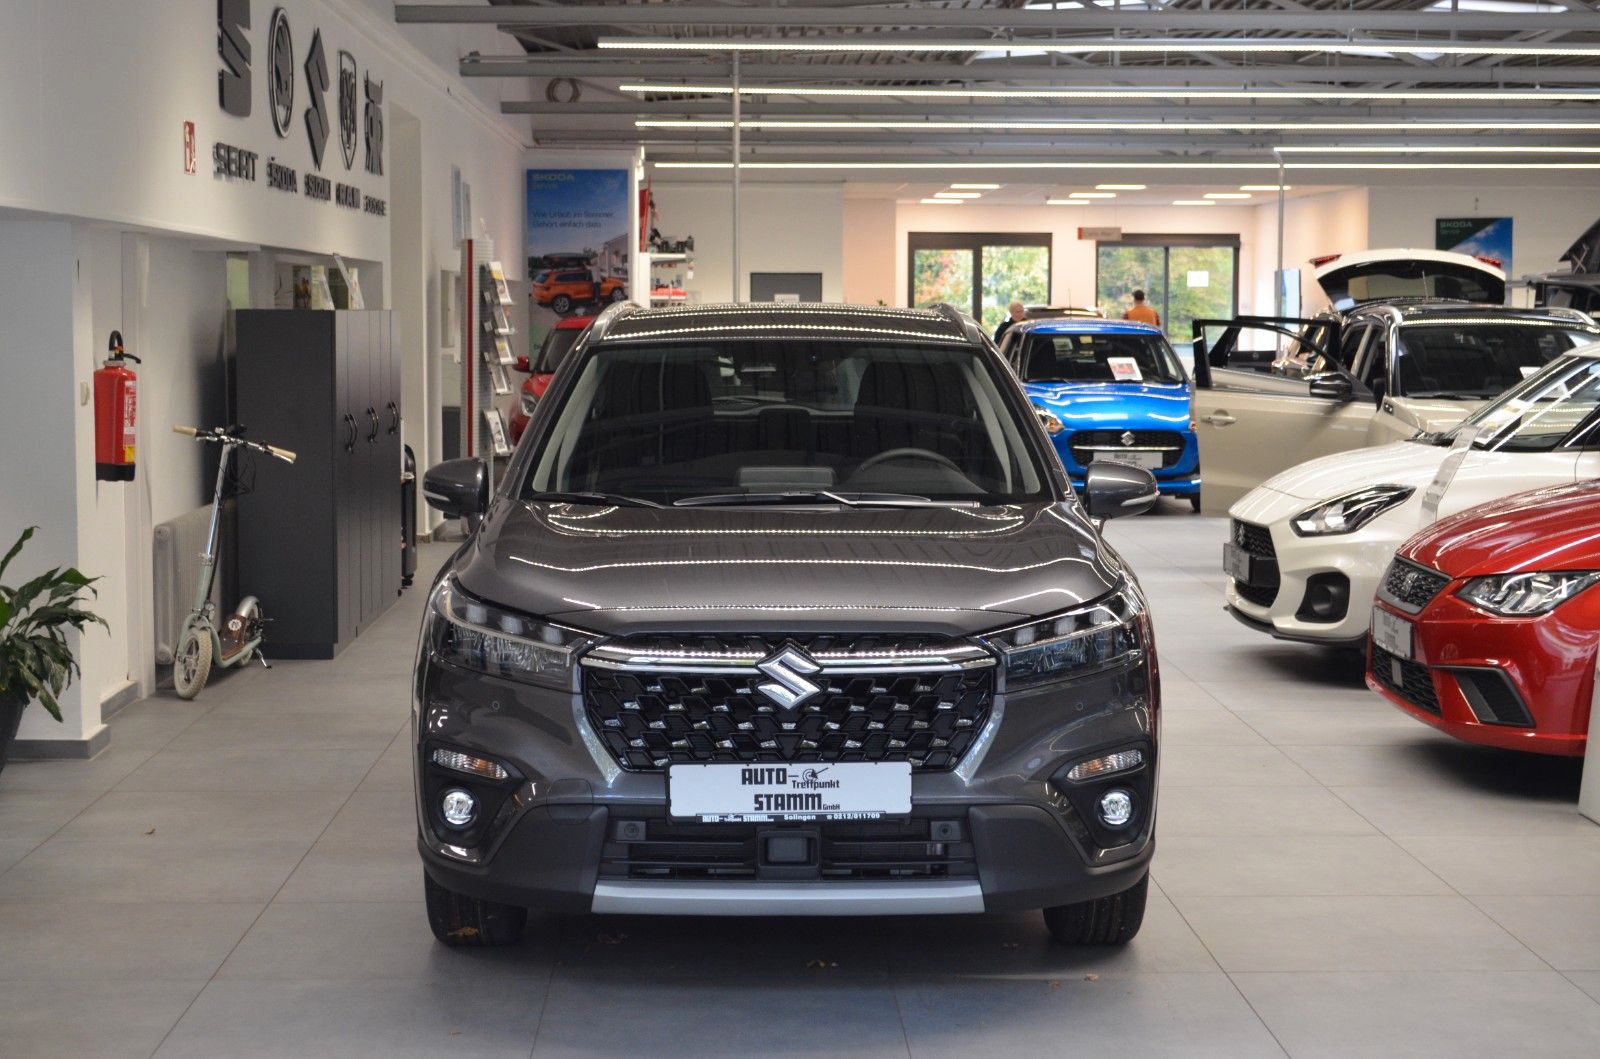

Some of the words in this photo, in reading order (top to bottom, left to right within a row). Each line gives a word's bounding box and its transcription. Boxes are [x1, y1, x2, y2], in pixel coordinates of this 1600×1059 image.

[213, 142, 259, 182] SEAT
[304, 173, 332, 201] SUZUKI
[791, 780, 840, 790] Treffpunkt
[754, 793, 822, 811] STAMM
[822, 803, 841, 811] GmbH
[784, 813, 817, 821] Solingen
